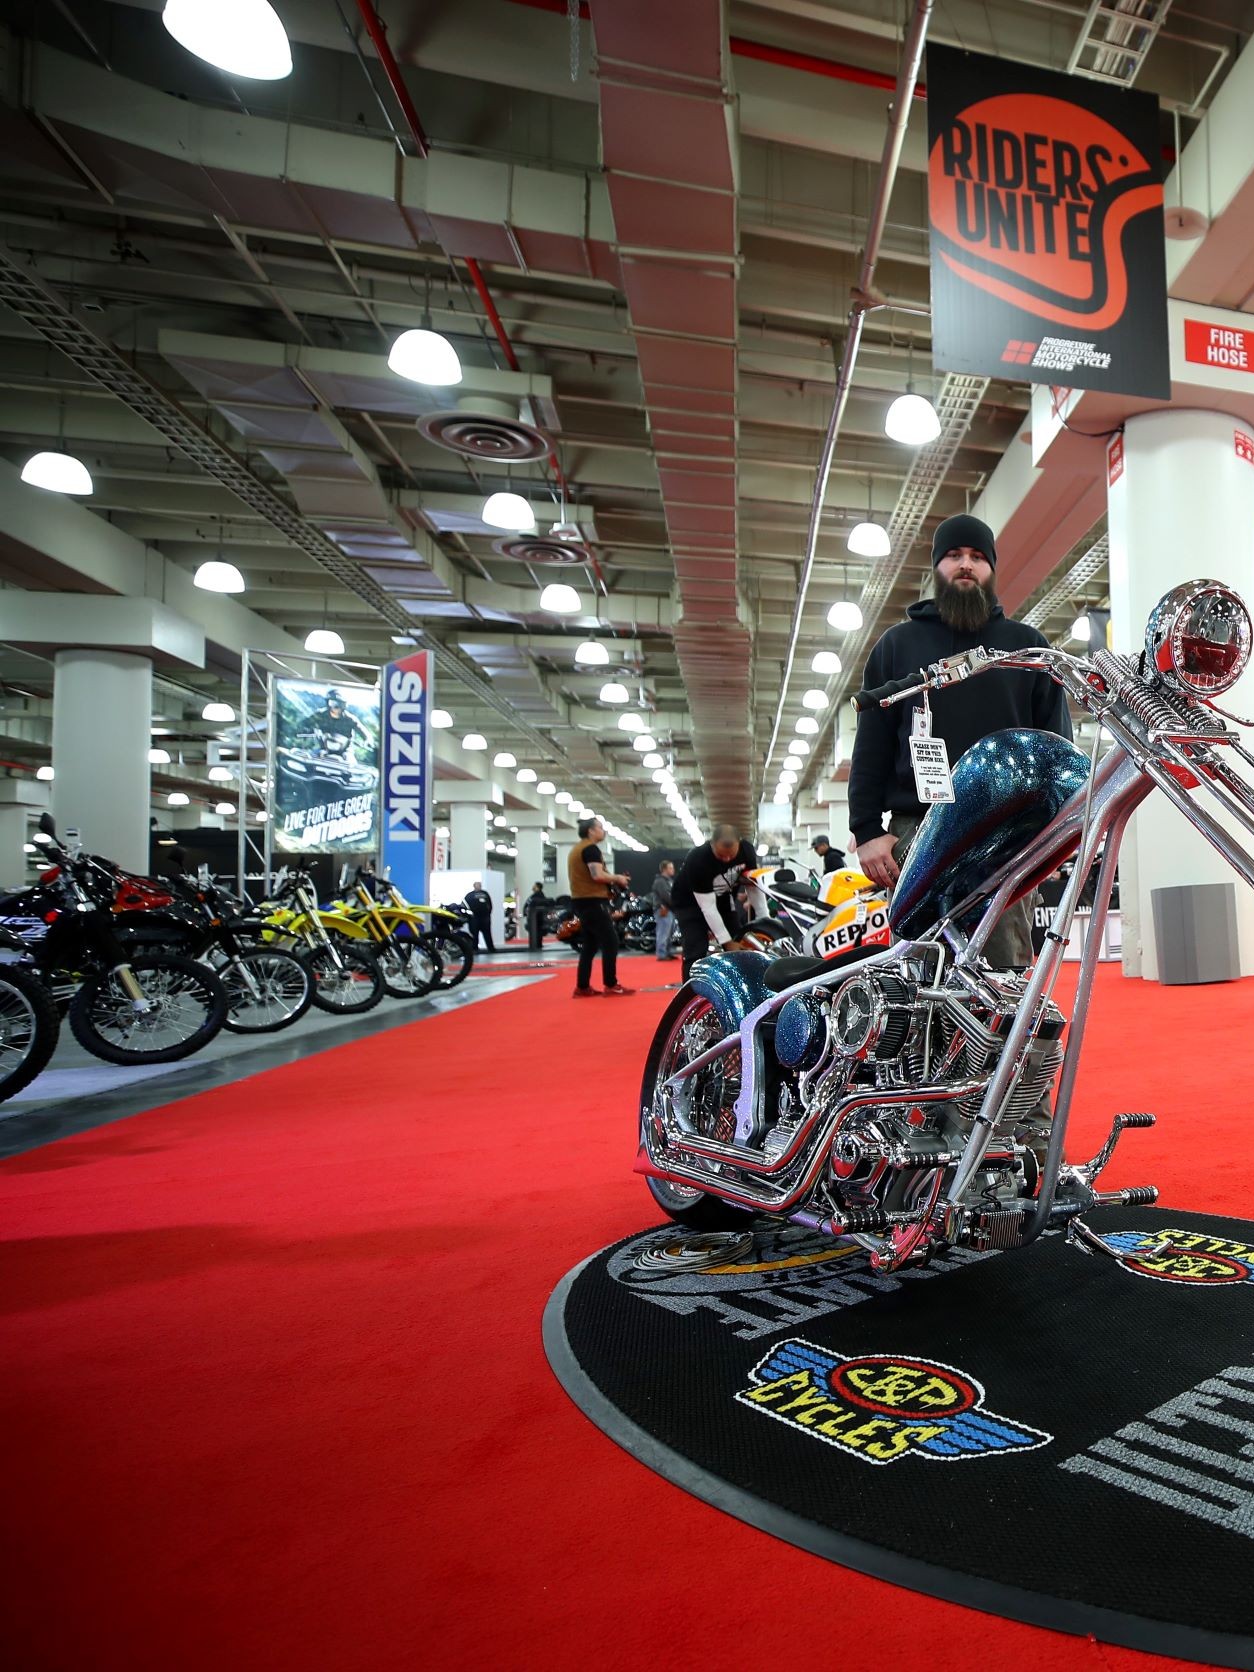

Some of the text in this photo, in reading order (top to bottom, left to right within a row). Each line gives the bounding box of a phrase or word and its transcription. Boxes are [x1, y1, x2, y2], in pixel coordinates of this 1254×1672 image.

[941, 117, 1113, 202] RIDERS
[954, 178, 1093, 263] UNITE
[1038, 343, 1112, 361] INTERNATIONAL
[1042, 336, 1097, 351] PROGRESSIVE
[1209, 327, 1245, 350] FIRE
[1031, 357, 1075, 372] SHOWS
[1034, 350, 1112, 370] MOTORCYCLE
[1207, 345, 1249, 368] HOSE
[388, 670, 423, 842] SUZUKI
[284, 792, 373, 833] LIVE FOR THE GREAT
[846, 1365, 958, 1406] J&P
[745, 1370, 951, 1459] CYCLES
